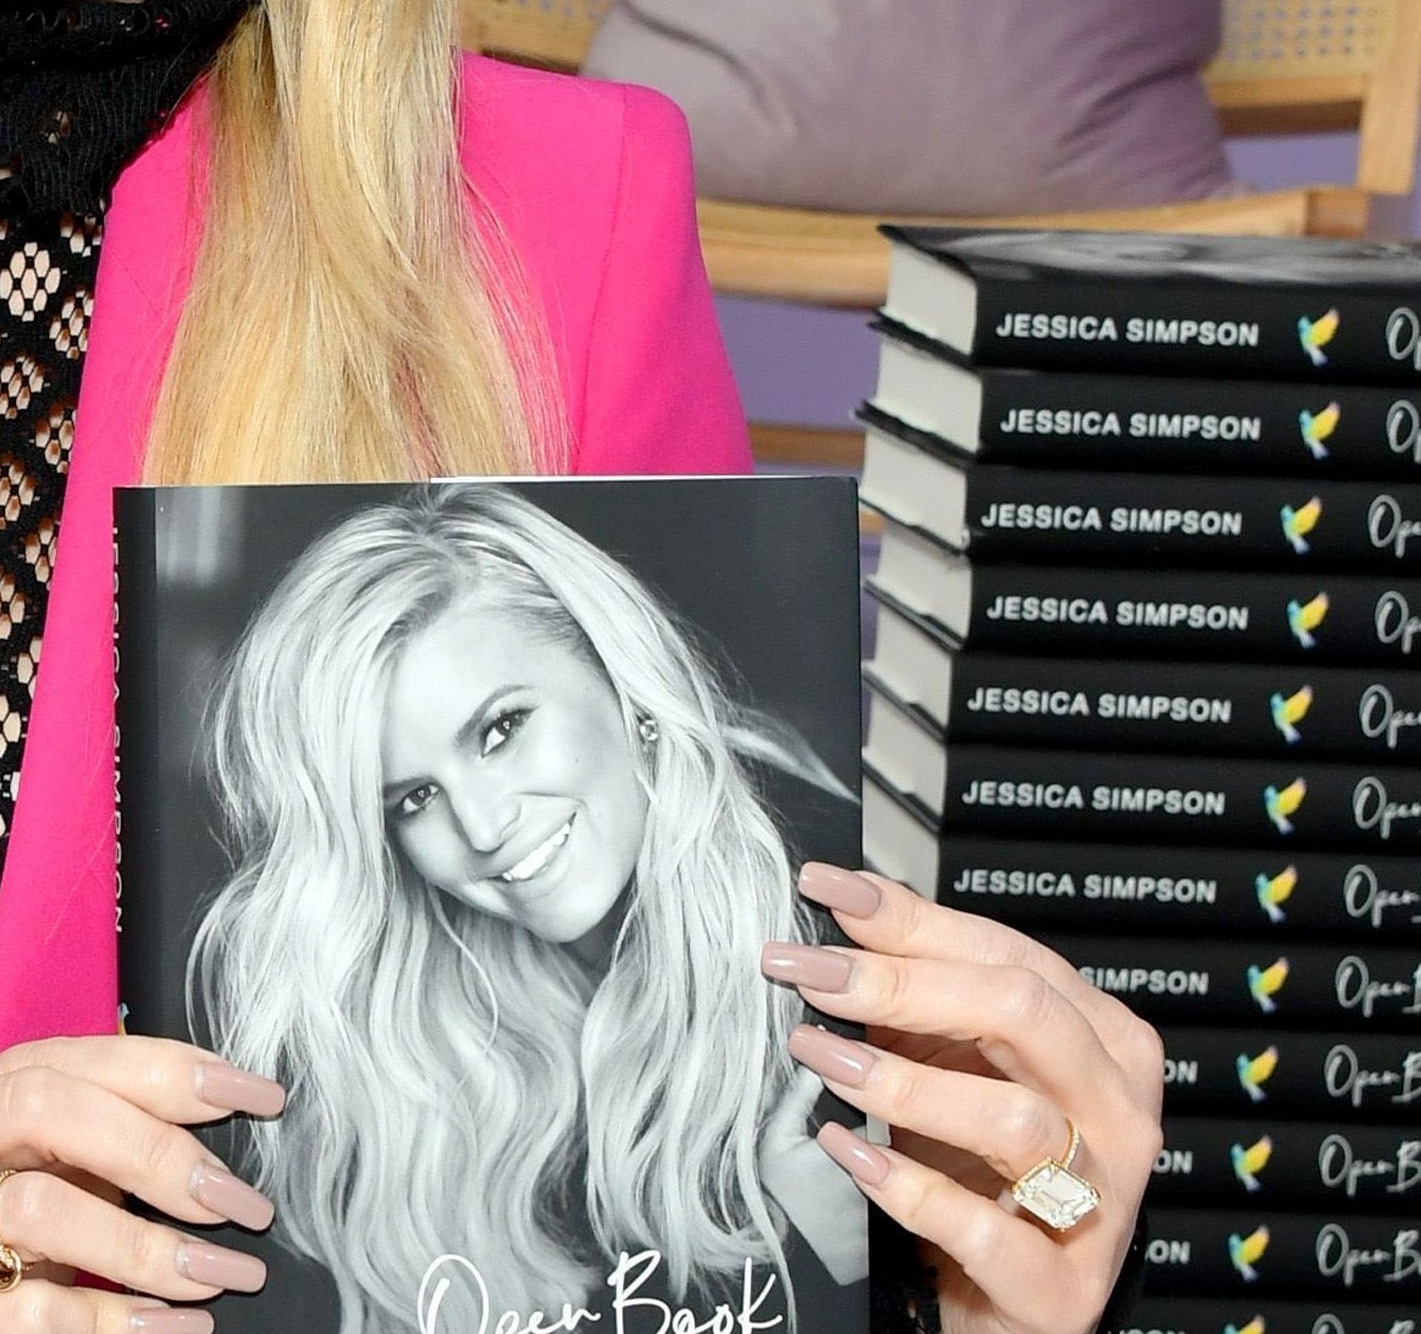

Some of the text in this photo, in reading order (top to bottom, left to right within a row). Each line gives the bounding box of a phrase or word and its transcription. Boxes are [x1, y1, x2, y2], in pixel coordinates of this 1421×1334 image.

[996, 313, 1260, 347] JESSICA SIMPSON
[1000, 408, 1261, 440] JESSICA SIMPSON
[981, 503, 1242, 536] JESSICA SIMPSON
[986, 596, 1249, 630] JESSICA SIMPSON
[1374, 590, 1421, 653] Op
[967, 687, 1232, 723] JESSICA SIMPSON
[962, 780, 1226, 815] JESSICA SIMPSON
[953, 869, 1217, 903] JESSICA SIMPSON
